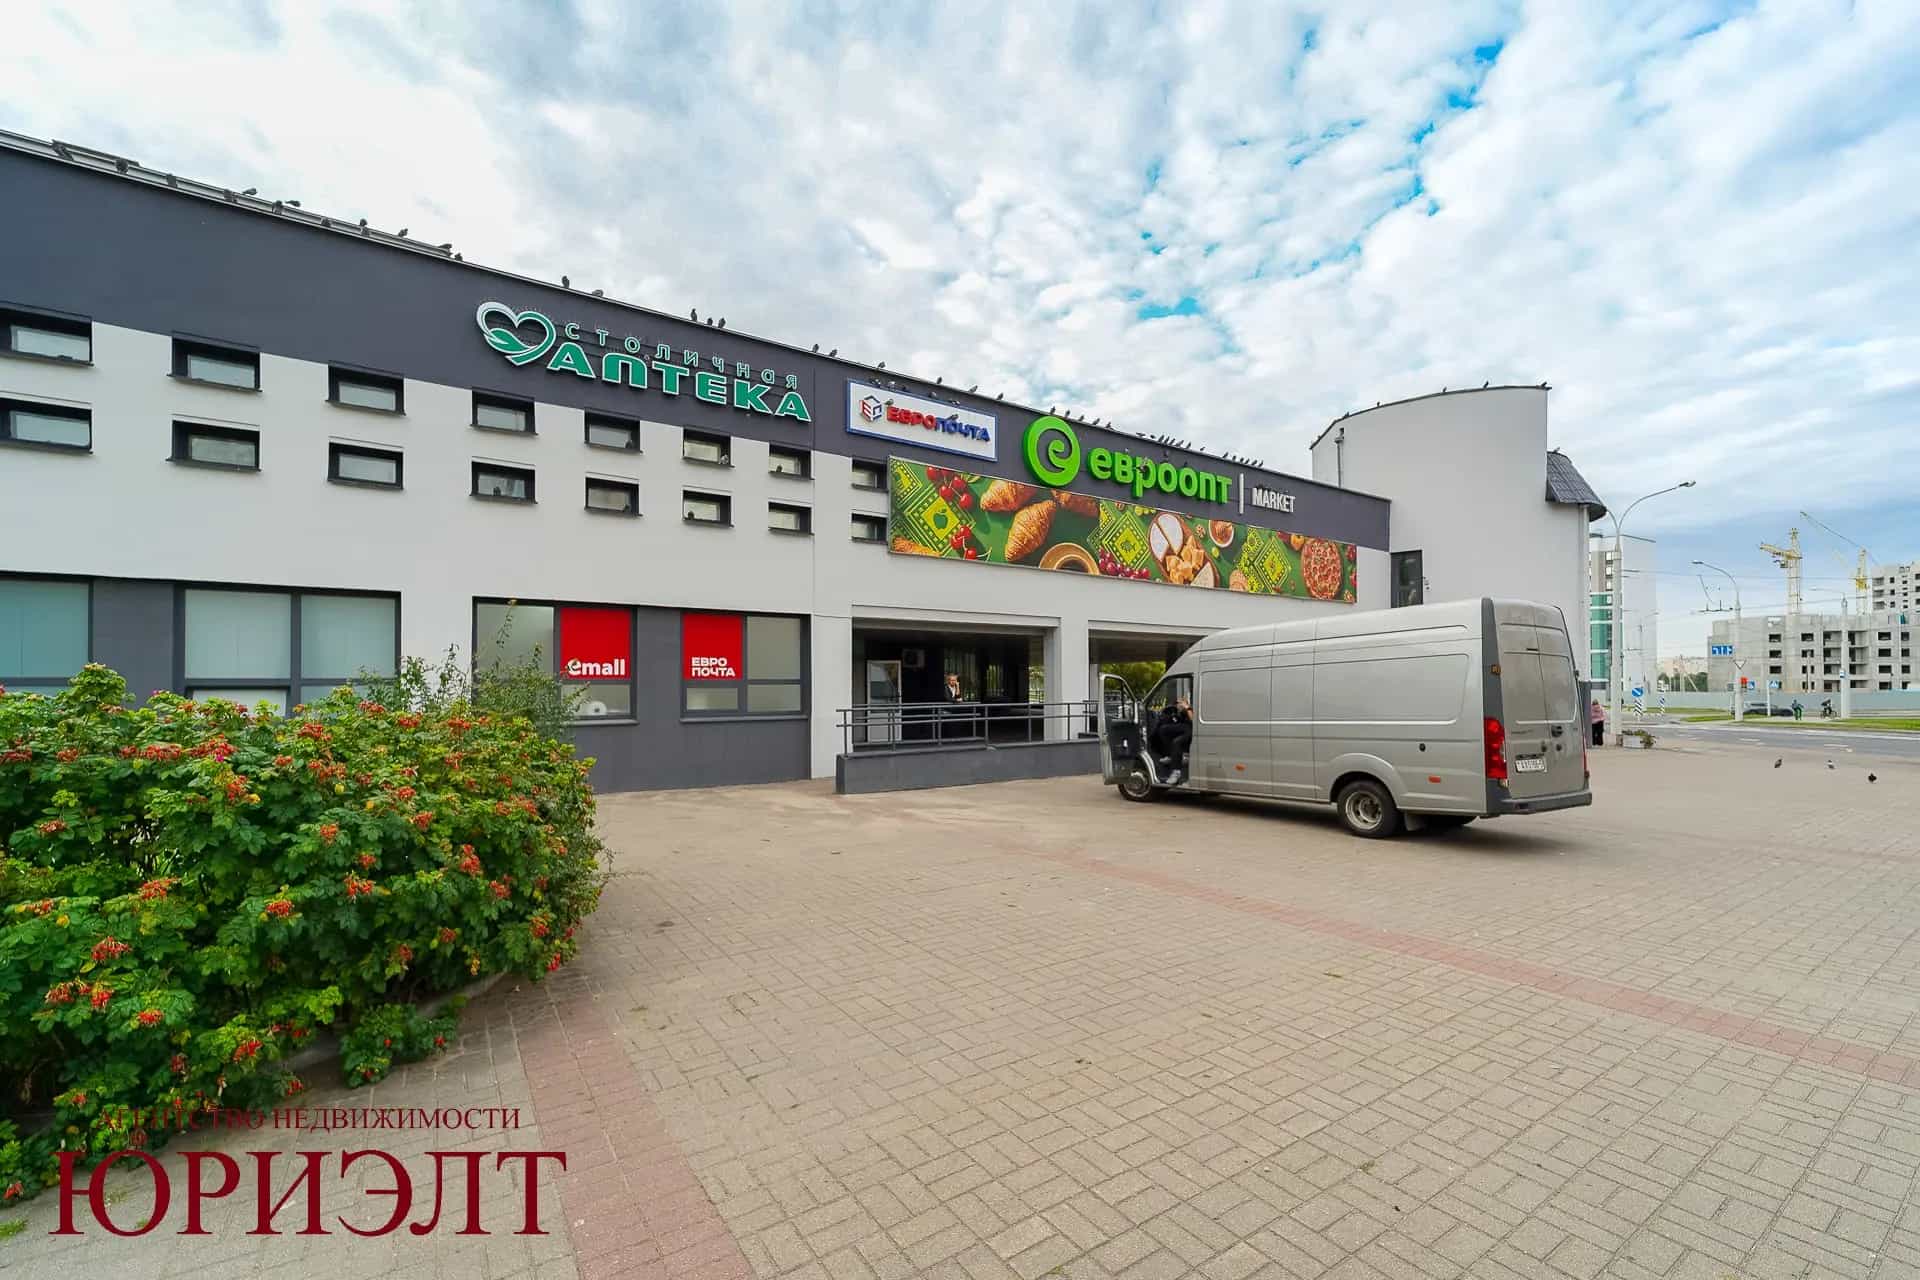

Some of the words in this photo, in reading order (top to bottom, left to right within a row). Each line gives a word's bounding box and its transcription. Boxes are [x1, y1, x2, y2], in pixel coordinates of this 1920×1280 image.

[547, 342, 812, 423] АПТЕКА
[1086, 447, 1233, 504] евроопт
[1252, 486, 1296, 513] MARKET
[567, 657, 626, 677] emall
[691, 656, 728, 668] ЕВРО
[691, 666, 736, 677] ПОЧТА
